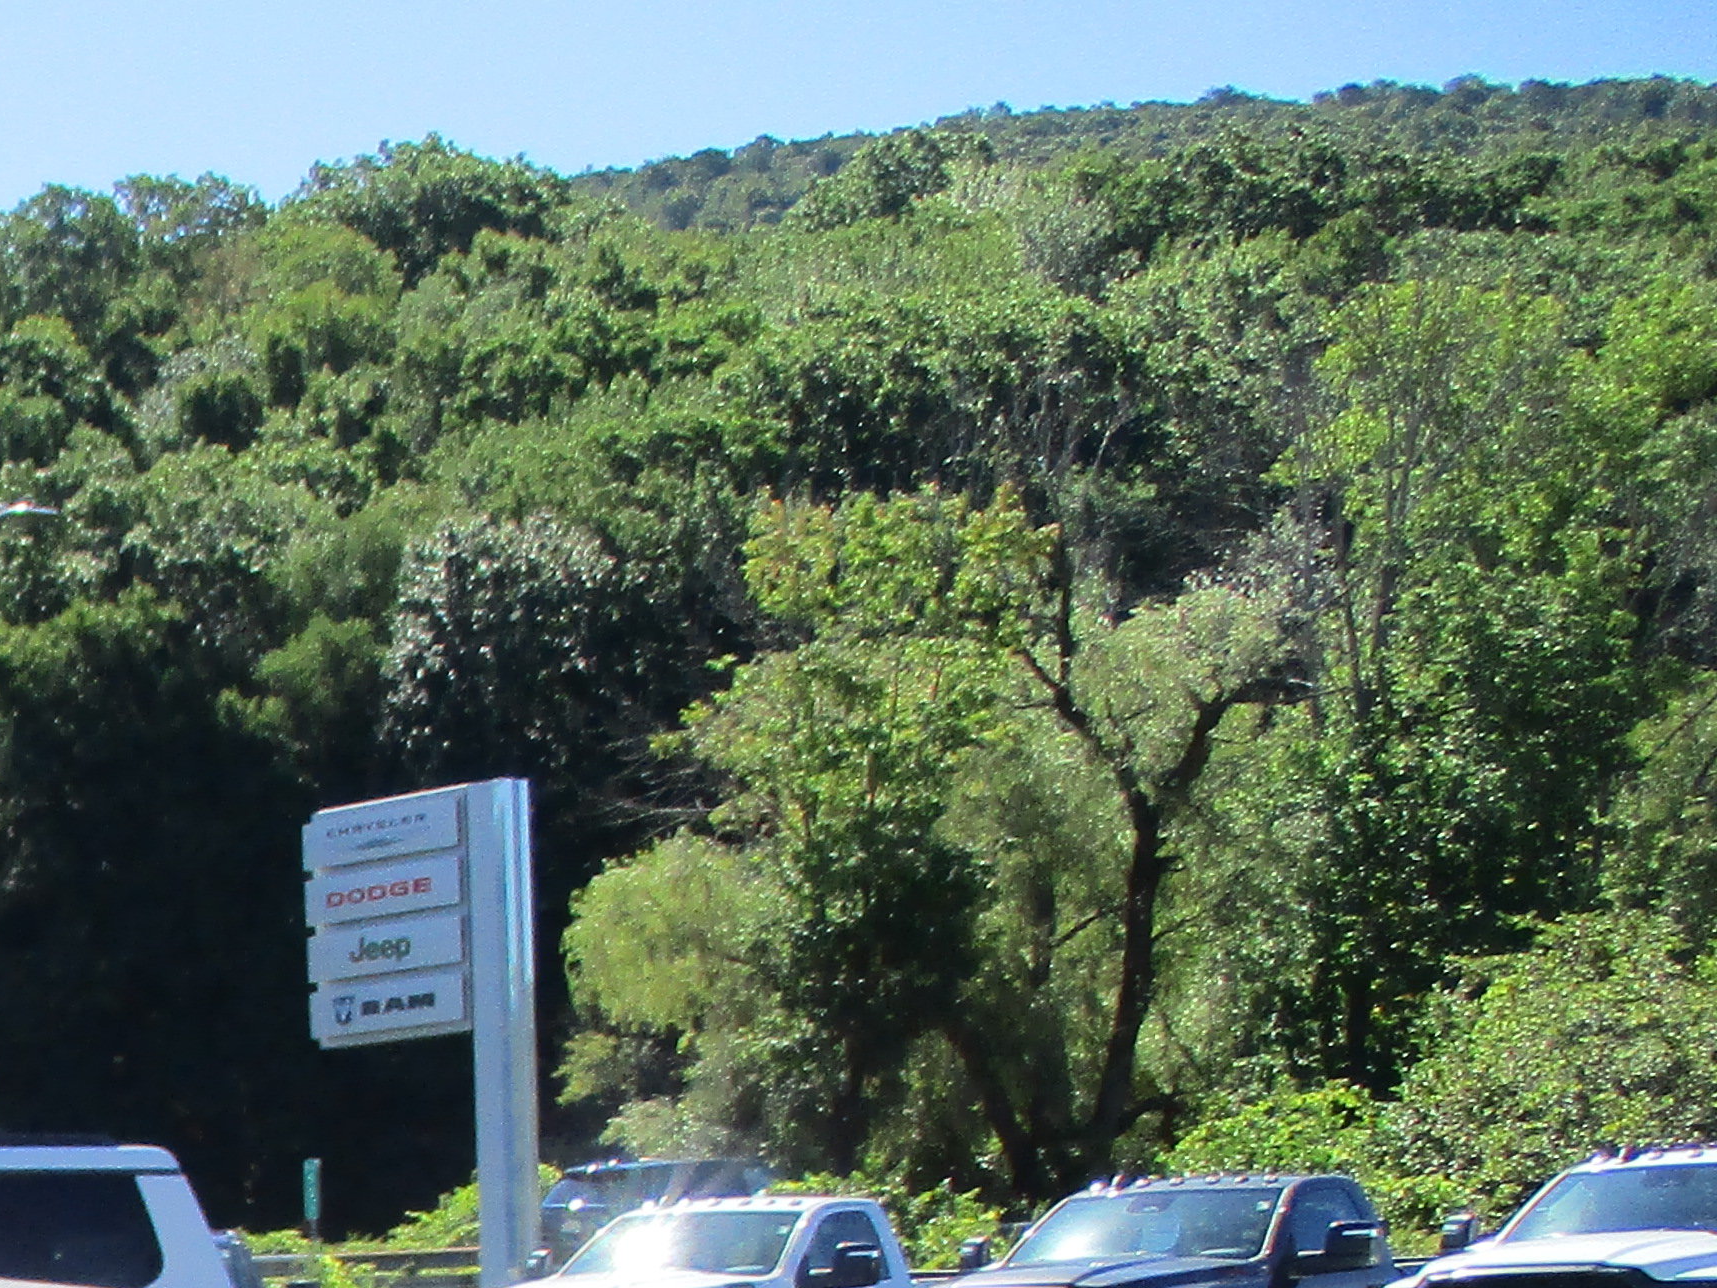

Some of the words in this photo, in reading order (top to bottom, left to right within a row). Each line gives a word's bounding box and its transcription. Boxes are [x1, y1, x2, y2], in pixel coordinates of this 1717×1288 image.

[326, 813, 427, 839] CHRYSLER
[326, 877, 433, 908] DODGE
[349, 937, 411, 962] Jeep
[361, 992, 436, 1017] RAM
